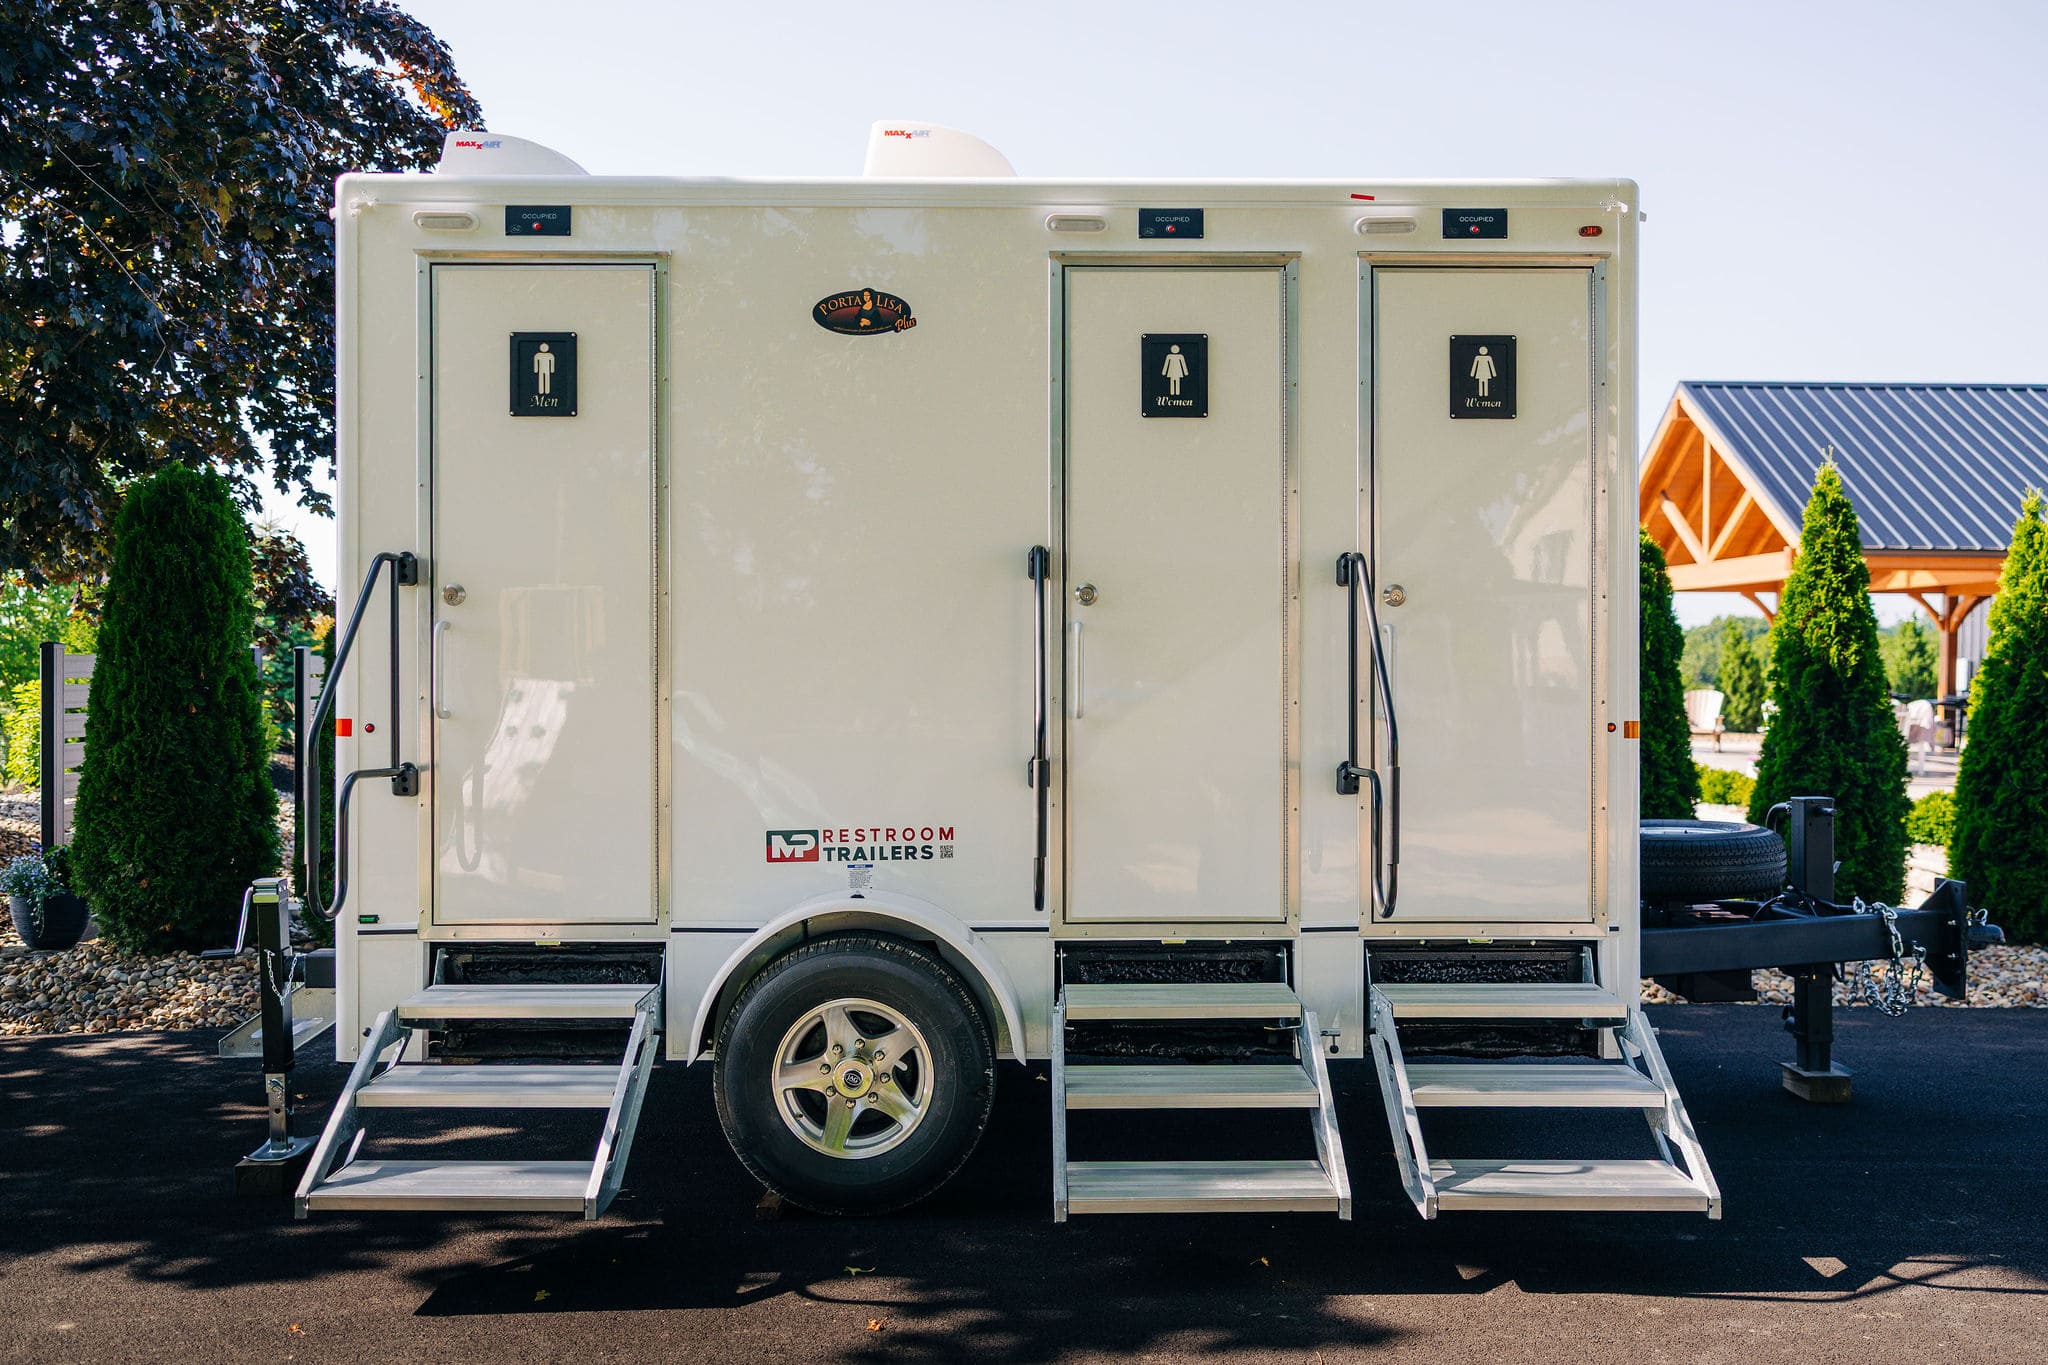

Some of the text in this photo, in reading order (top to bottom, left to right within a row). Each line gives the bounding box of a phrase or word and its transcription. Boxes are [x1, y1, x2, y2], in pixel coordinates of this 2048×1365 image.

[819, 294, 903, 316] PORTA LISA
[895, 314, 917, 331] Plus
[530, 395, 559, 407] Men
[1155, 396, 1193, 406] Women
[1465, 397, 1502, 408] Women
[822, 826, 955, 843] RESTROOM
[771, 833, 816, 859] MP
[822, 845, 934, 862] TRAILERS
